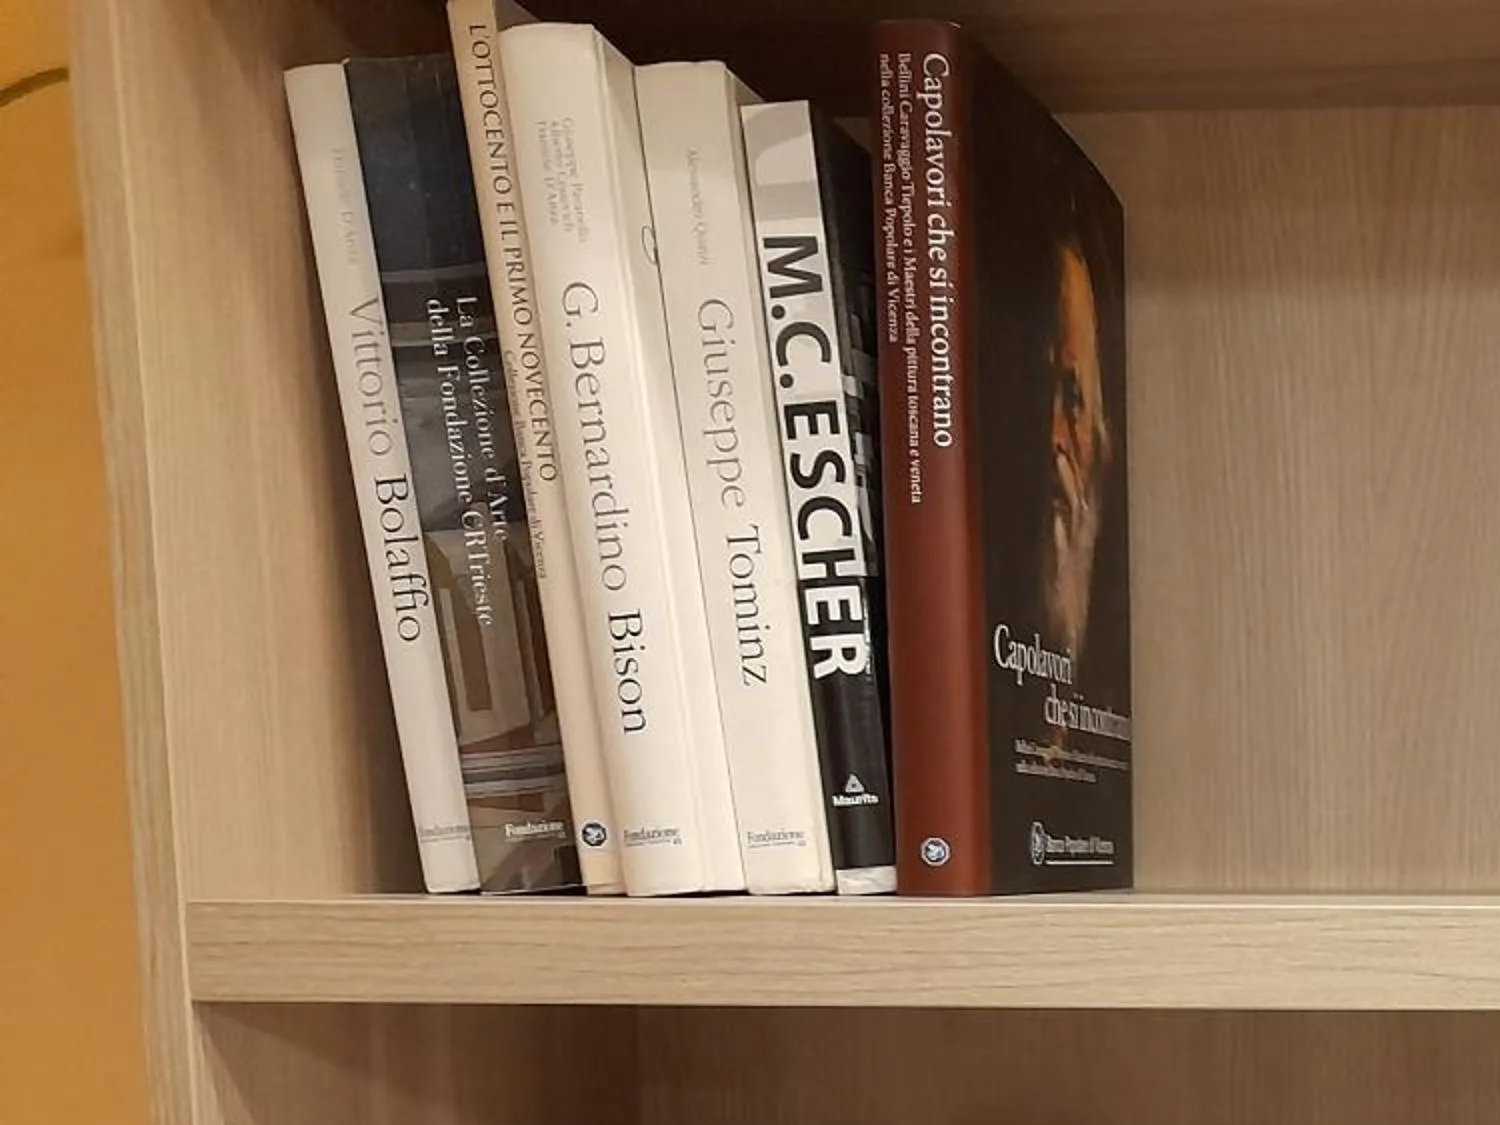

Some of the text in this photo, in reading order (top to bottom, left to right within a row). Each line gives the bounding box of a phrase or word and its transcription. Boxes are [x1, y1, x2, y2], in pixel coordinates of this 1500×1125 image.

[898, 53, 913, 97] Bellini
[898, 100, 914, 179] Caravaggio
[880, 53, 900, 342] nella collezione Banca Popolare di Vicenza
[899, 182, 916, 236] Tiepolo
[469, 24, 557, 481] L'OTTOCENTO E IL PRIMO NOVECENTO
[902, 238, 913, 246] e
[917, 53, 955, 448] Capolavori che si incontrano
[562, 282, 599, 327] G.
[902, 257, 918, 308] Maestri
[905, 311, 921, 343] della
[903, 346, 921, 392] pittura
[458, 297, 509, 541] La Collezione d'Arte
[763, 236, 870, 680] M.C. ESCHER
[908, 395, 921, 445] toscana
[347, 297, 430, 641] Vittorio Bolaffio
[426, 299, 494, 625] della Fondazione CRTrieste
[569, 338, 630, 591] Bernardino
[698, 298, 747, 508] Giuseppe
[726, 523, 770, 687] Tominz
[910, 459, 922, 503] veneta
[608, 608, 648, 734] Bison
[994, 624, 1072, 685] Capolavori
